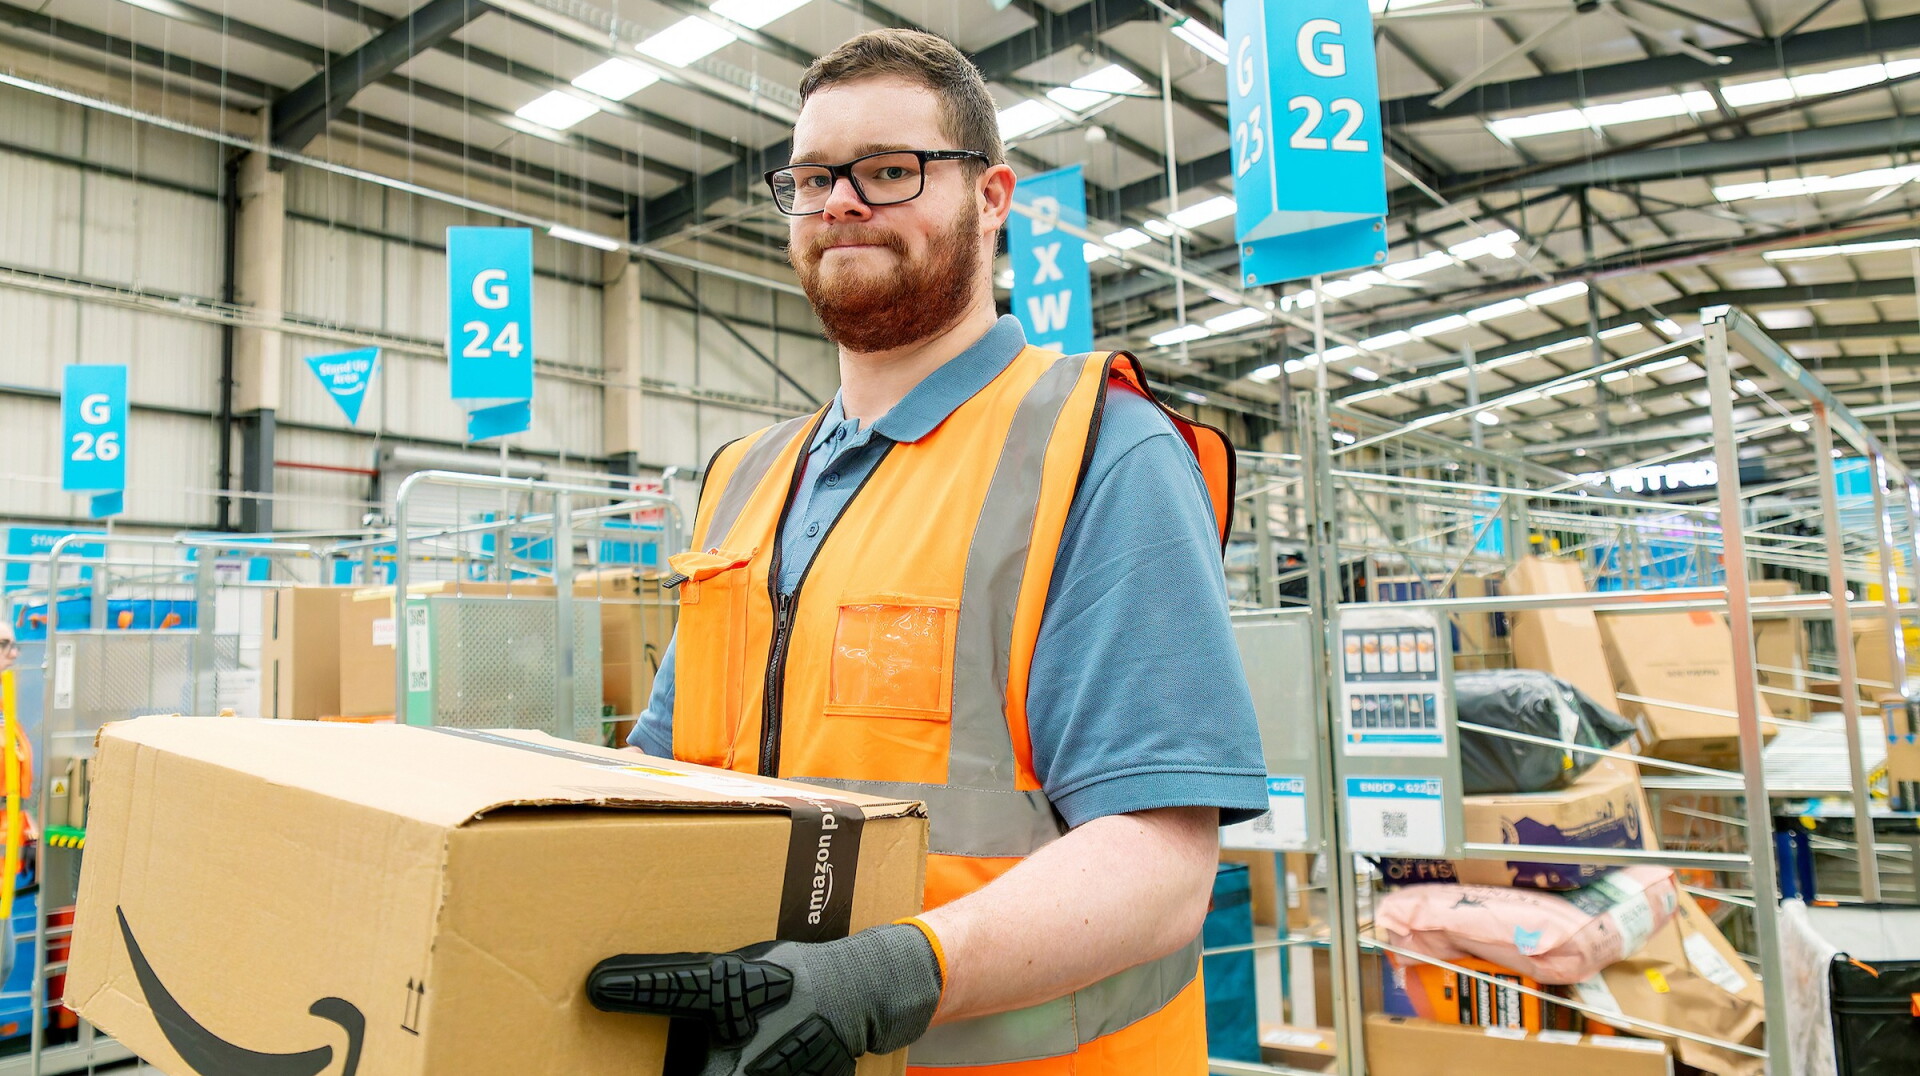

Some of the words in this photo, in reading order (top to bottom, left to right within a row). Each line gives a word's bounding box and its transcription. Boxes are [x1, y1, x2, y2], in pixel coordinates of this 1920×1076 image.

[1236, 34, 1254, 98] G
[1296, 18, 1347, 78] G
[1235, 104, 1265, 180] 23
[1288, 95, 1369, 152] 22
[471, 268, 510, 310] G
[462, 320, 524, 358] 24
[319, 360, 351, 376] Stand
[352, 360, 369, 373] Up
[333, 372, 359, 385] Area
[80, 393, 111, 425] G
[71, 431, 120, 462] 26
[807, 834, 833, 925] amazon
